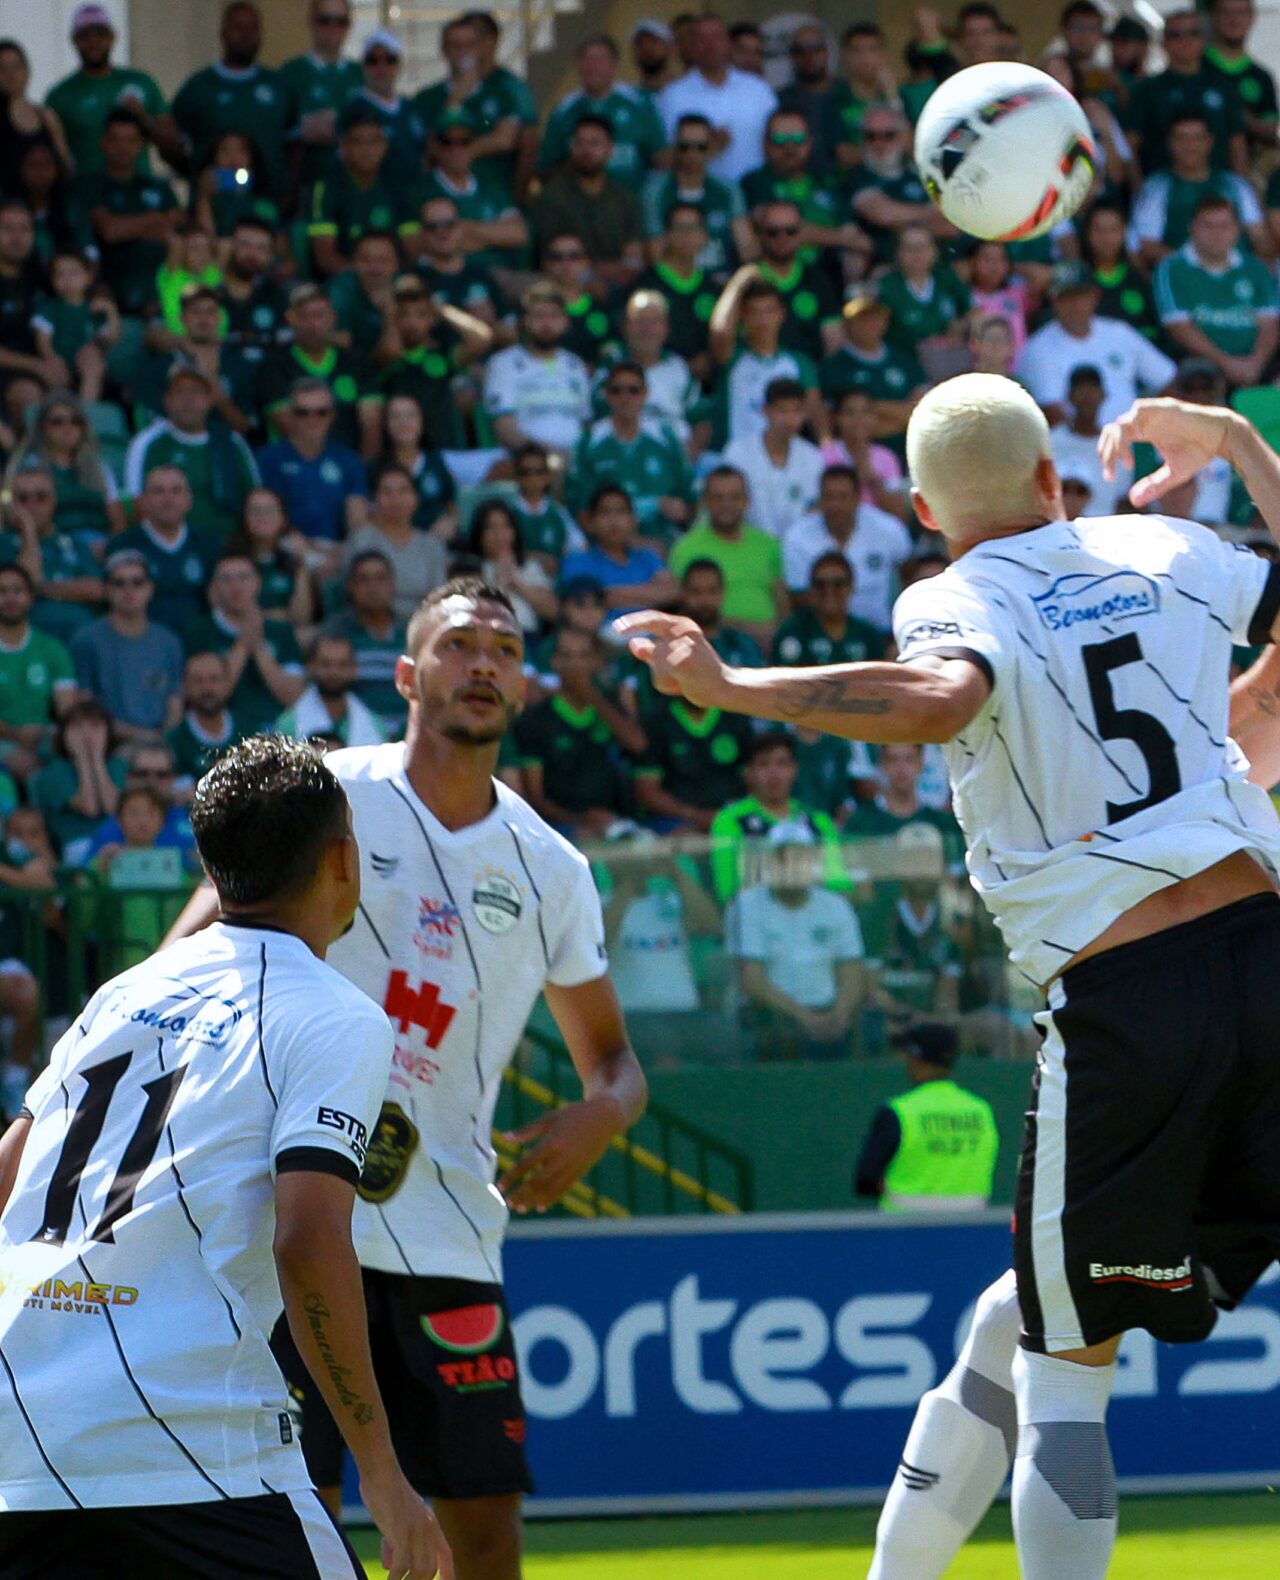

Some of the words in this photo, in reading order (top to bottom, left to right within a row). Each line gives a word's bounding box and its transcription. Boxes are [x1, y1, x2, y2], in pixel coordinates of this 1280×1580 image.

[1082, 631, 1181, 825] 5
[34, 1050, 188, 1246] 11
[1089, 1254, 1191, 1280] Eurodiesel
